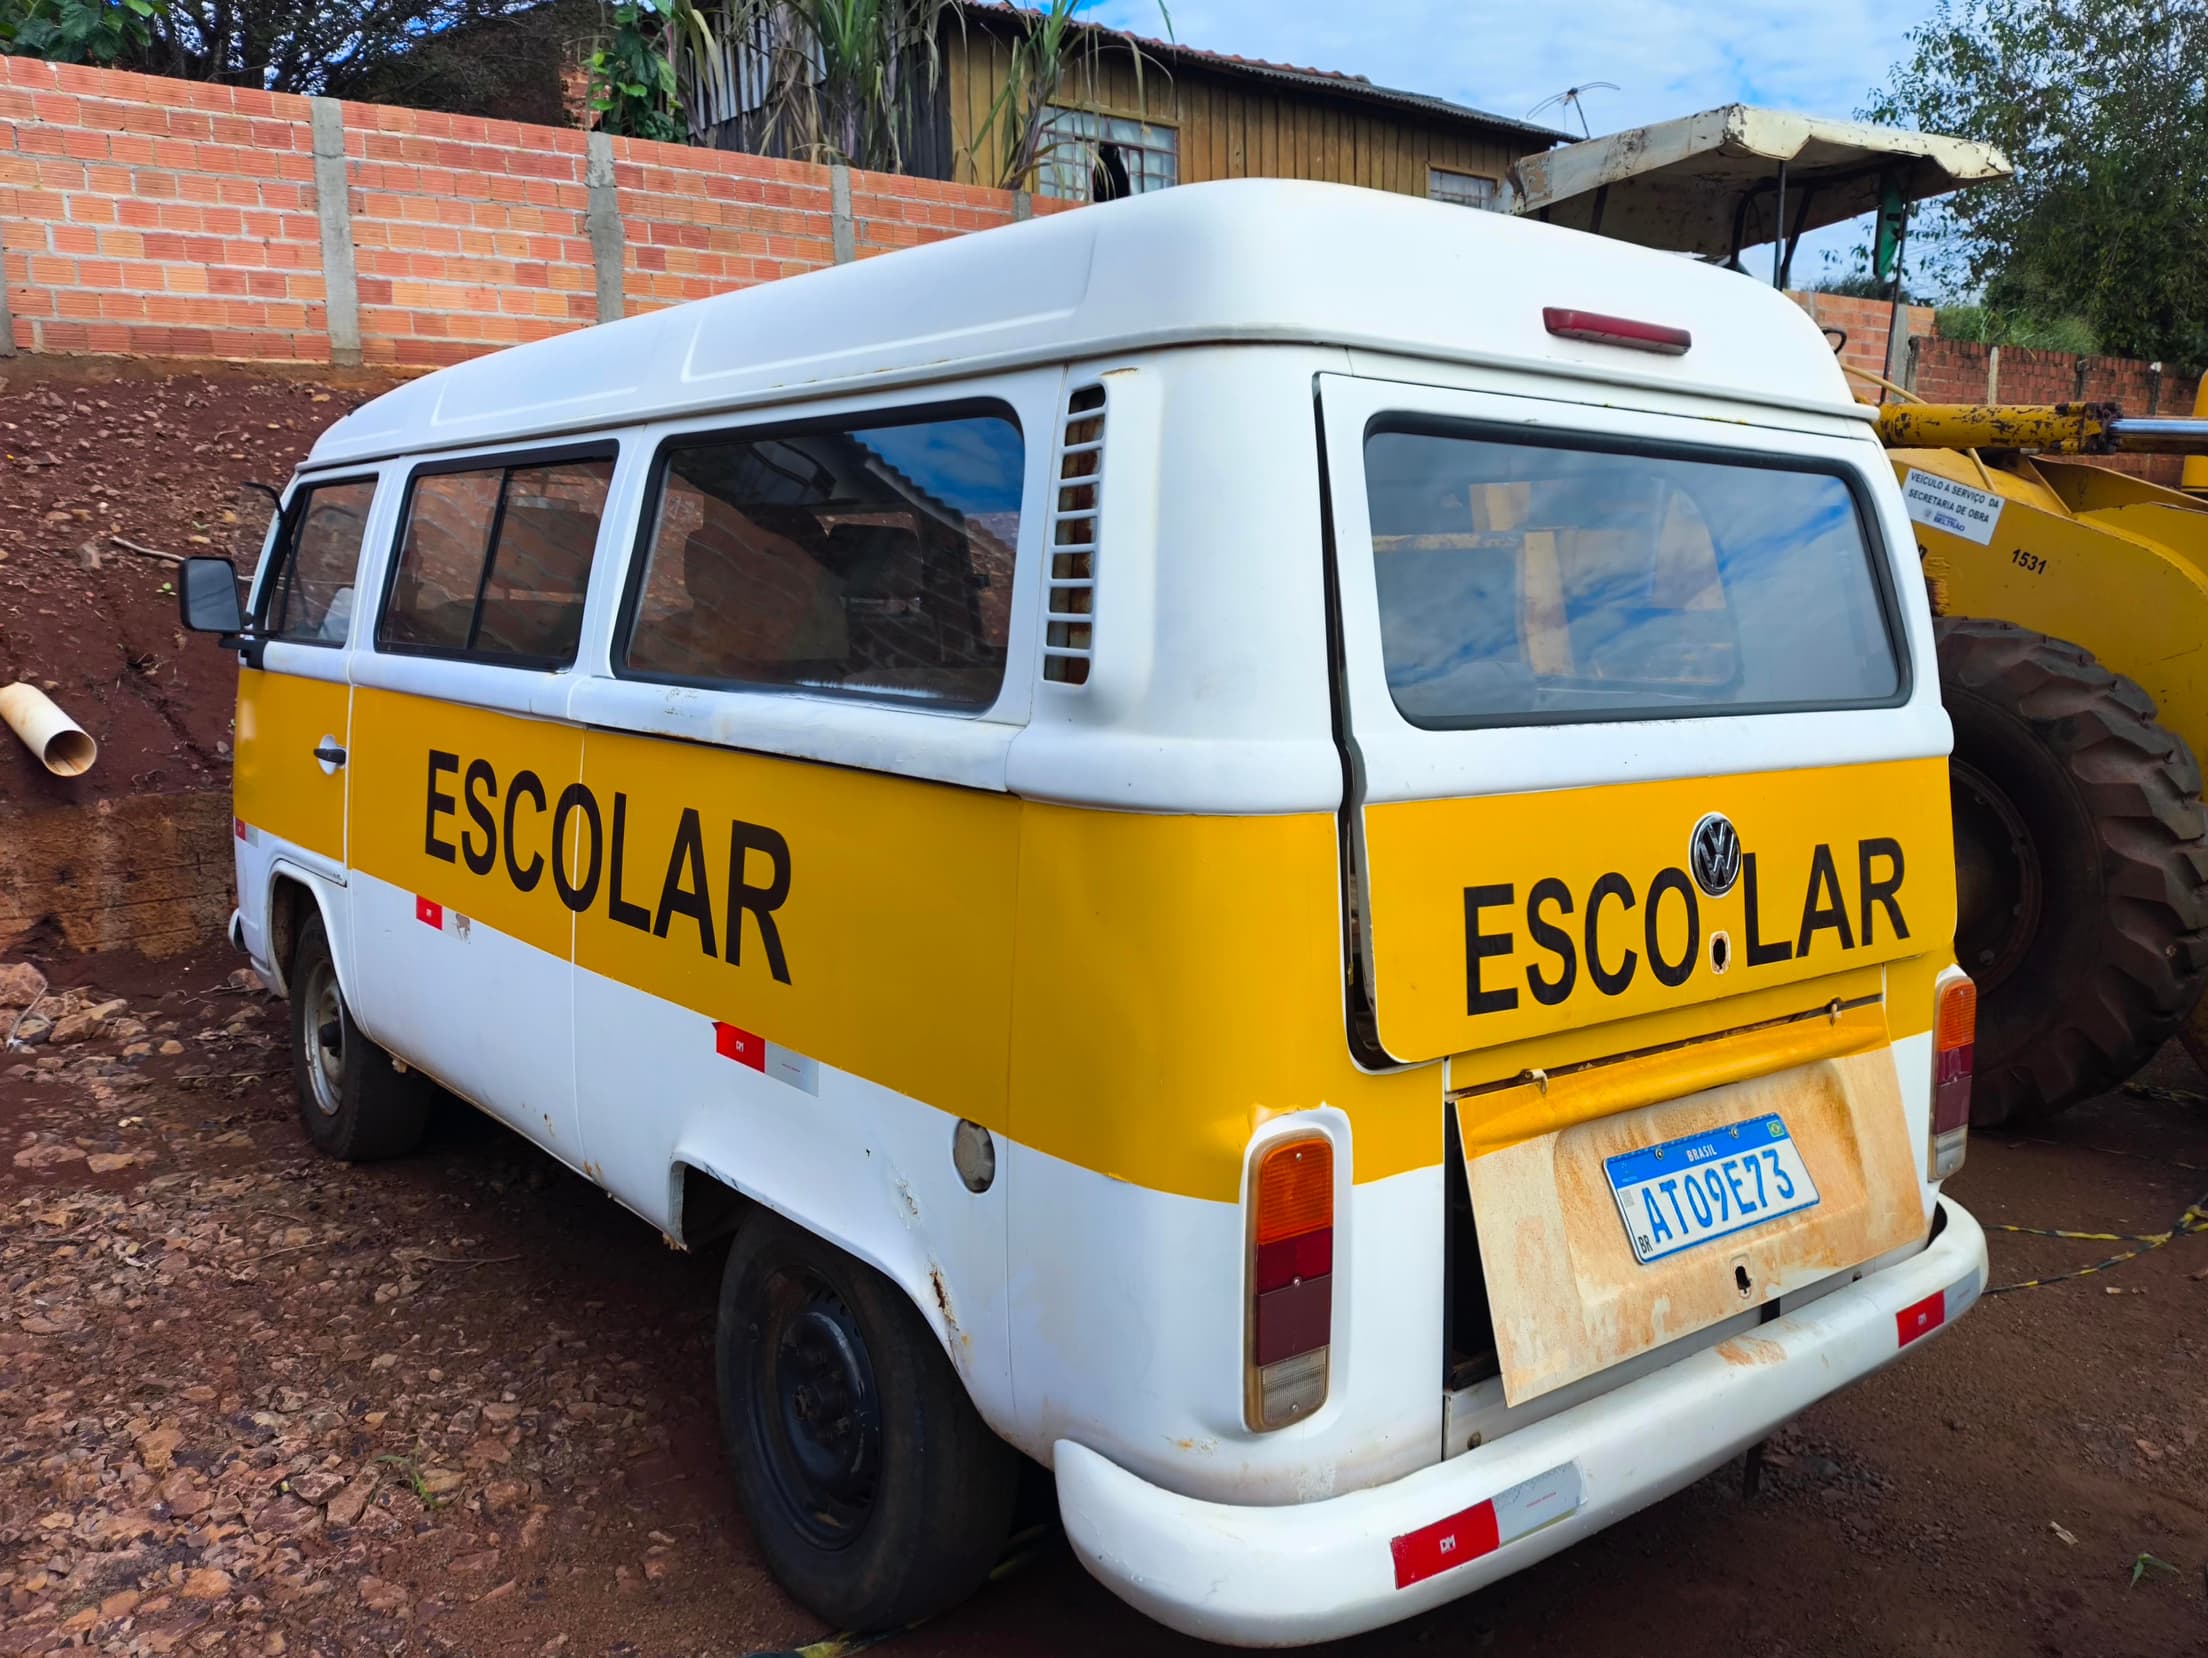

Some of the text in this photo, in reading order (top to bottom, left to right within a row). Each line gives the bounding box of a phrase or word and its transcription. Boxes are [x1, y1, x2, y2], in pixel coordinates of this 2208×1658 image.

[1908, 489, 1954, 511] SECRETARIA
[1956, 506, 1966, 515] DE
[1967, 508, 1989, 523] OBRA
[1951, 486, 1986, 504] SERVIÇO
[1988, 498, 1999, 508] DA
[2012, 548, 2047, 575] 1531
[425, 749, 793, 986] ESCOLAR
[1463, 836, 1910, 1017] ESCOLAR
[1686, 1144, 1717, 1161] BRASIL
[1638, 1234, 1653, 1254] BR
